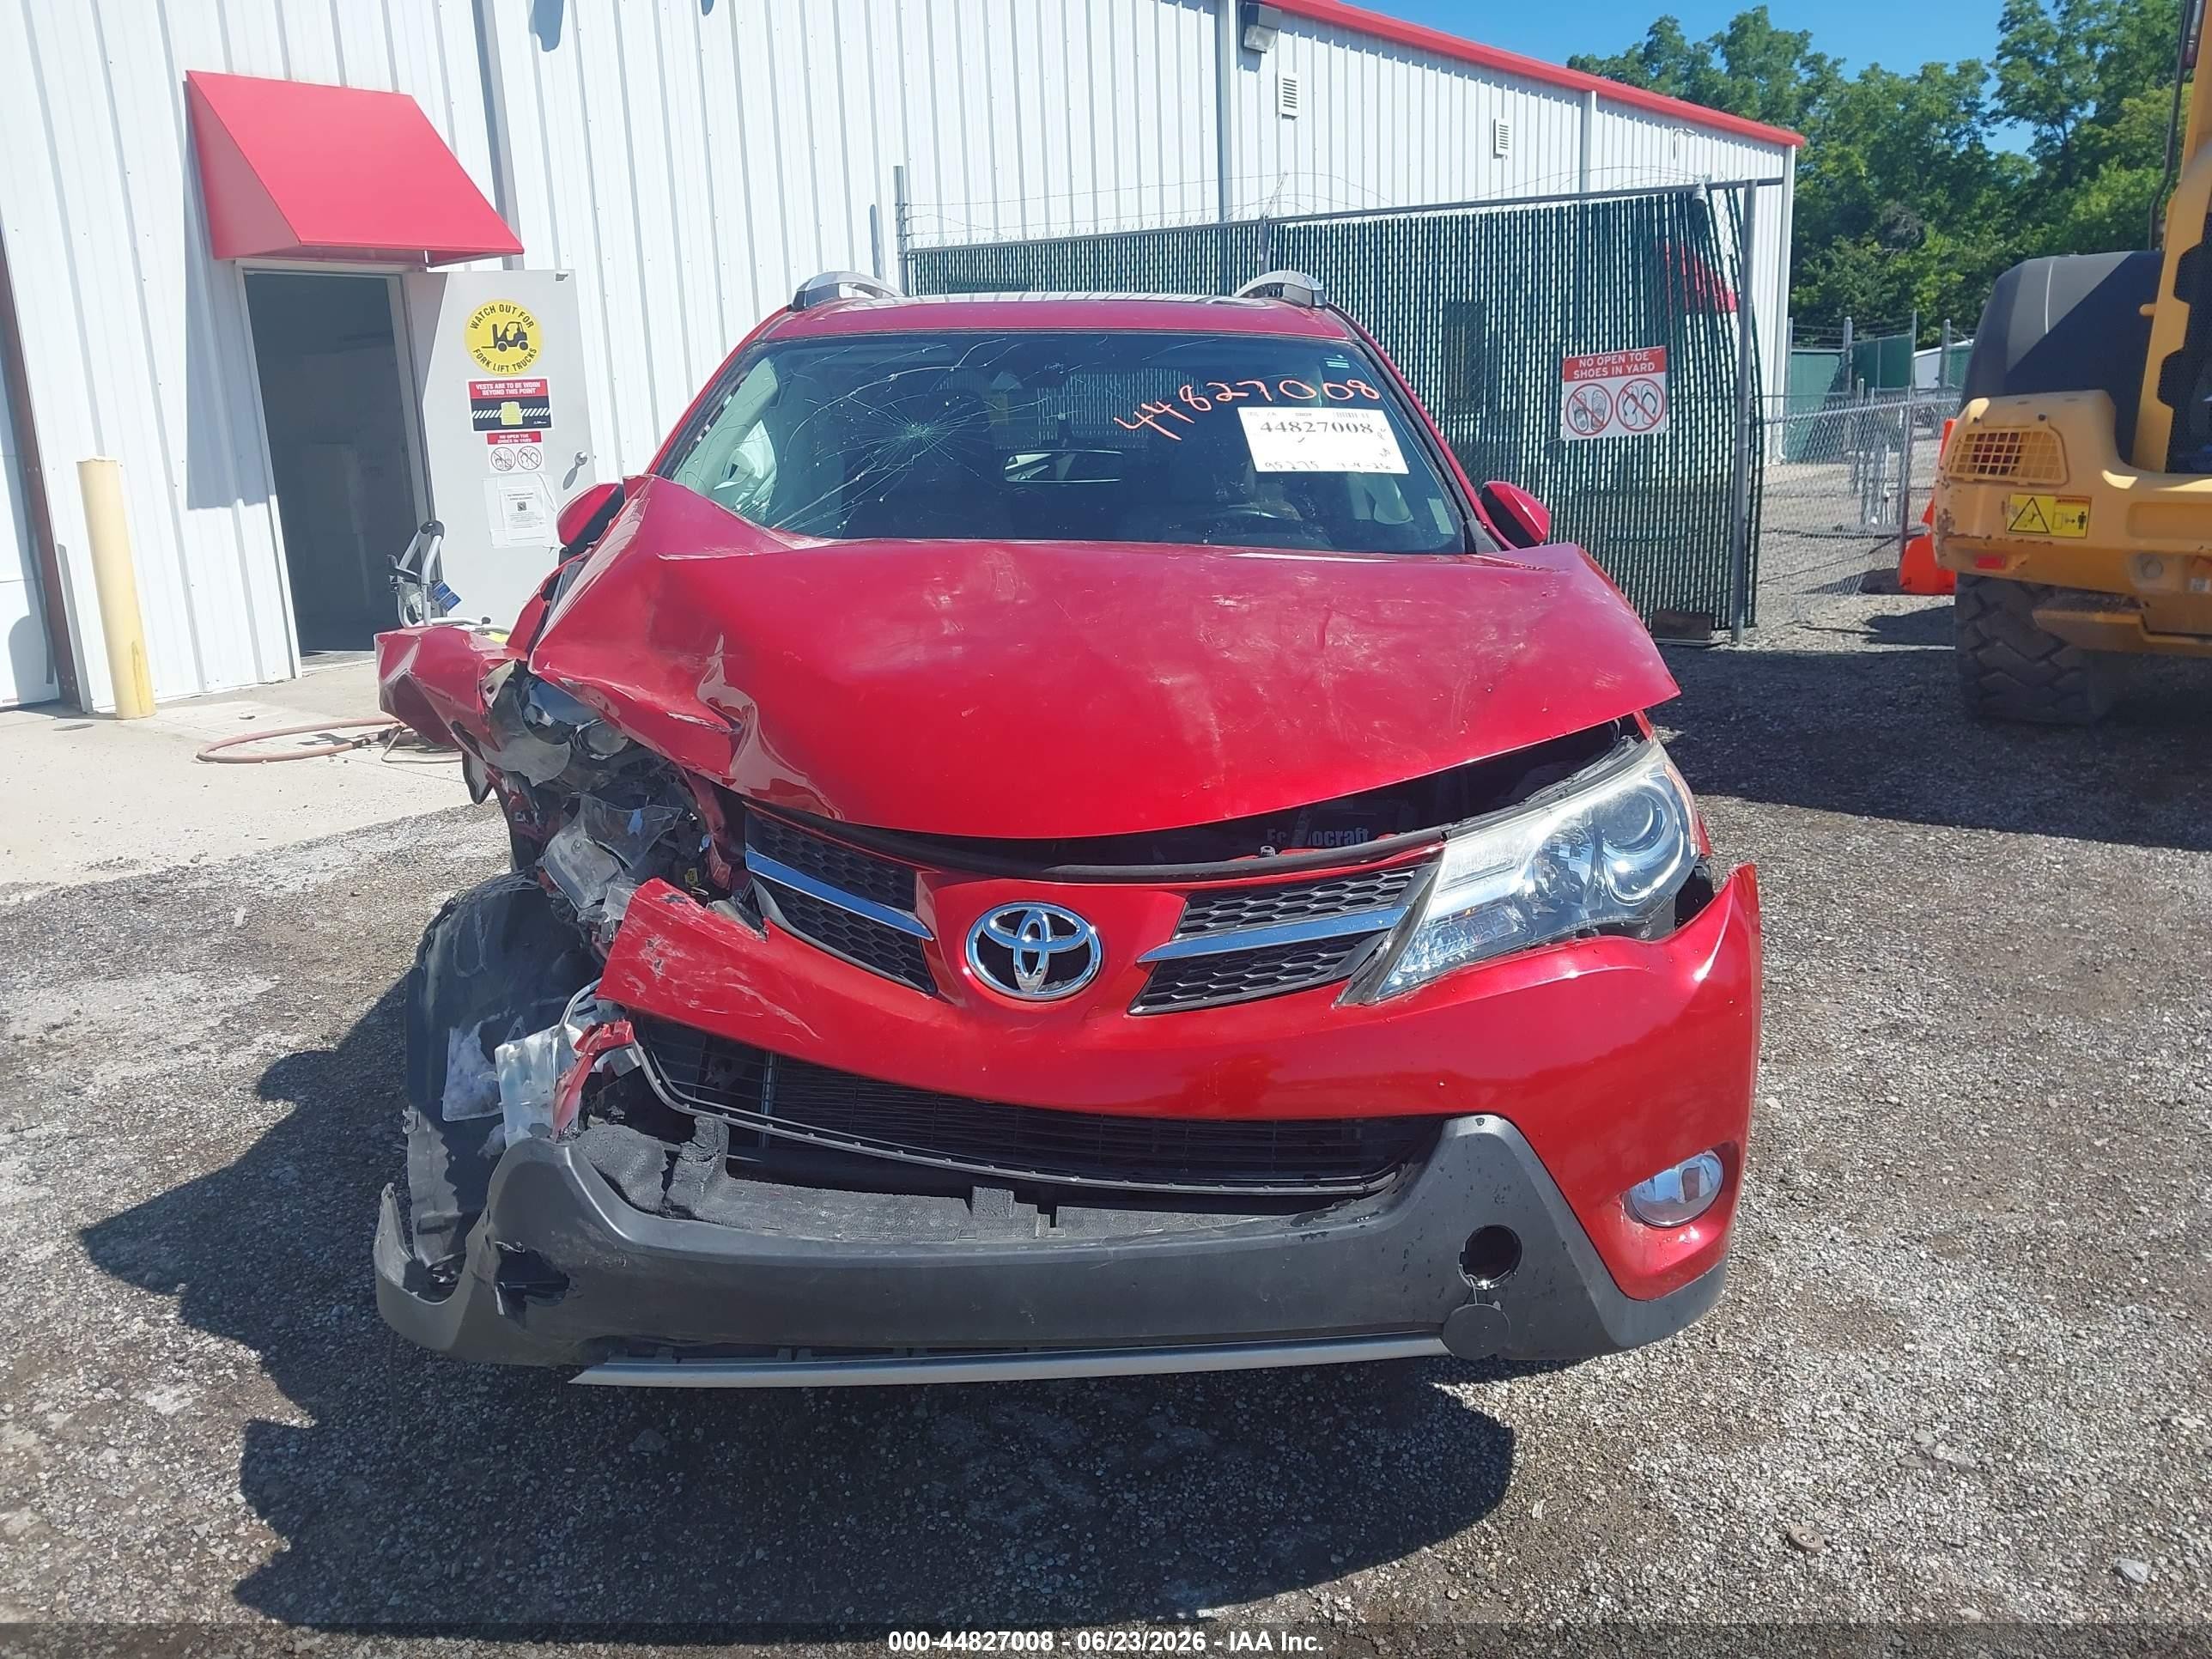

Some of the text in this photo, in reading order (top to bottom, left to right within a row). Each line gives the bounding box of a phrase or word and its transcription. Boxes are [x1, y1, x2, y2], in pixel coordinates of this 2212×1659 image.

[470, 304, 535, 330] WATCH OUT FOR
[472, 348, 538, 373] FORK LIFT TRUCKS
[1579, 351, 1650, 368] NO OPEN TOE
[1573, 362, 1656, 380] SHOES IN YARD
[1113, 379, 1380, 441] 44827008
[1260, 421, 1374, 434] 44827008
[1266, 827, 1369, 847] Ecocraft
